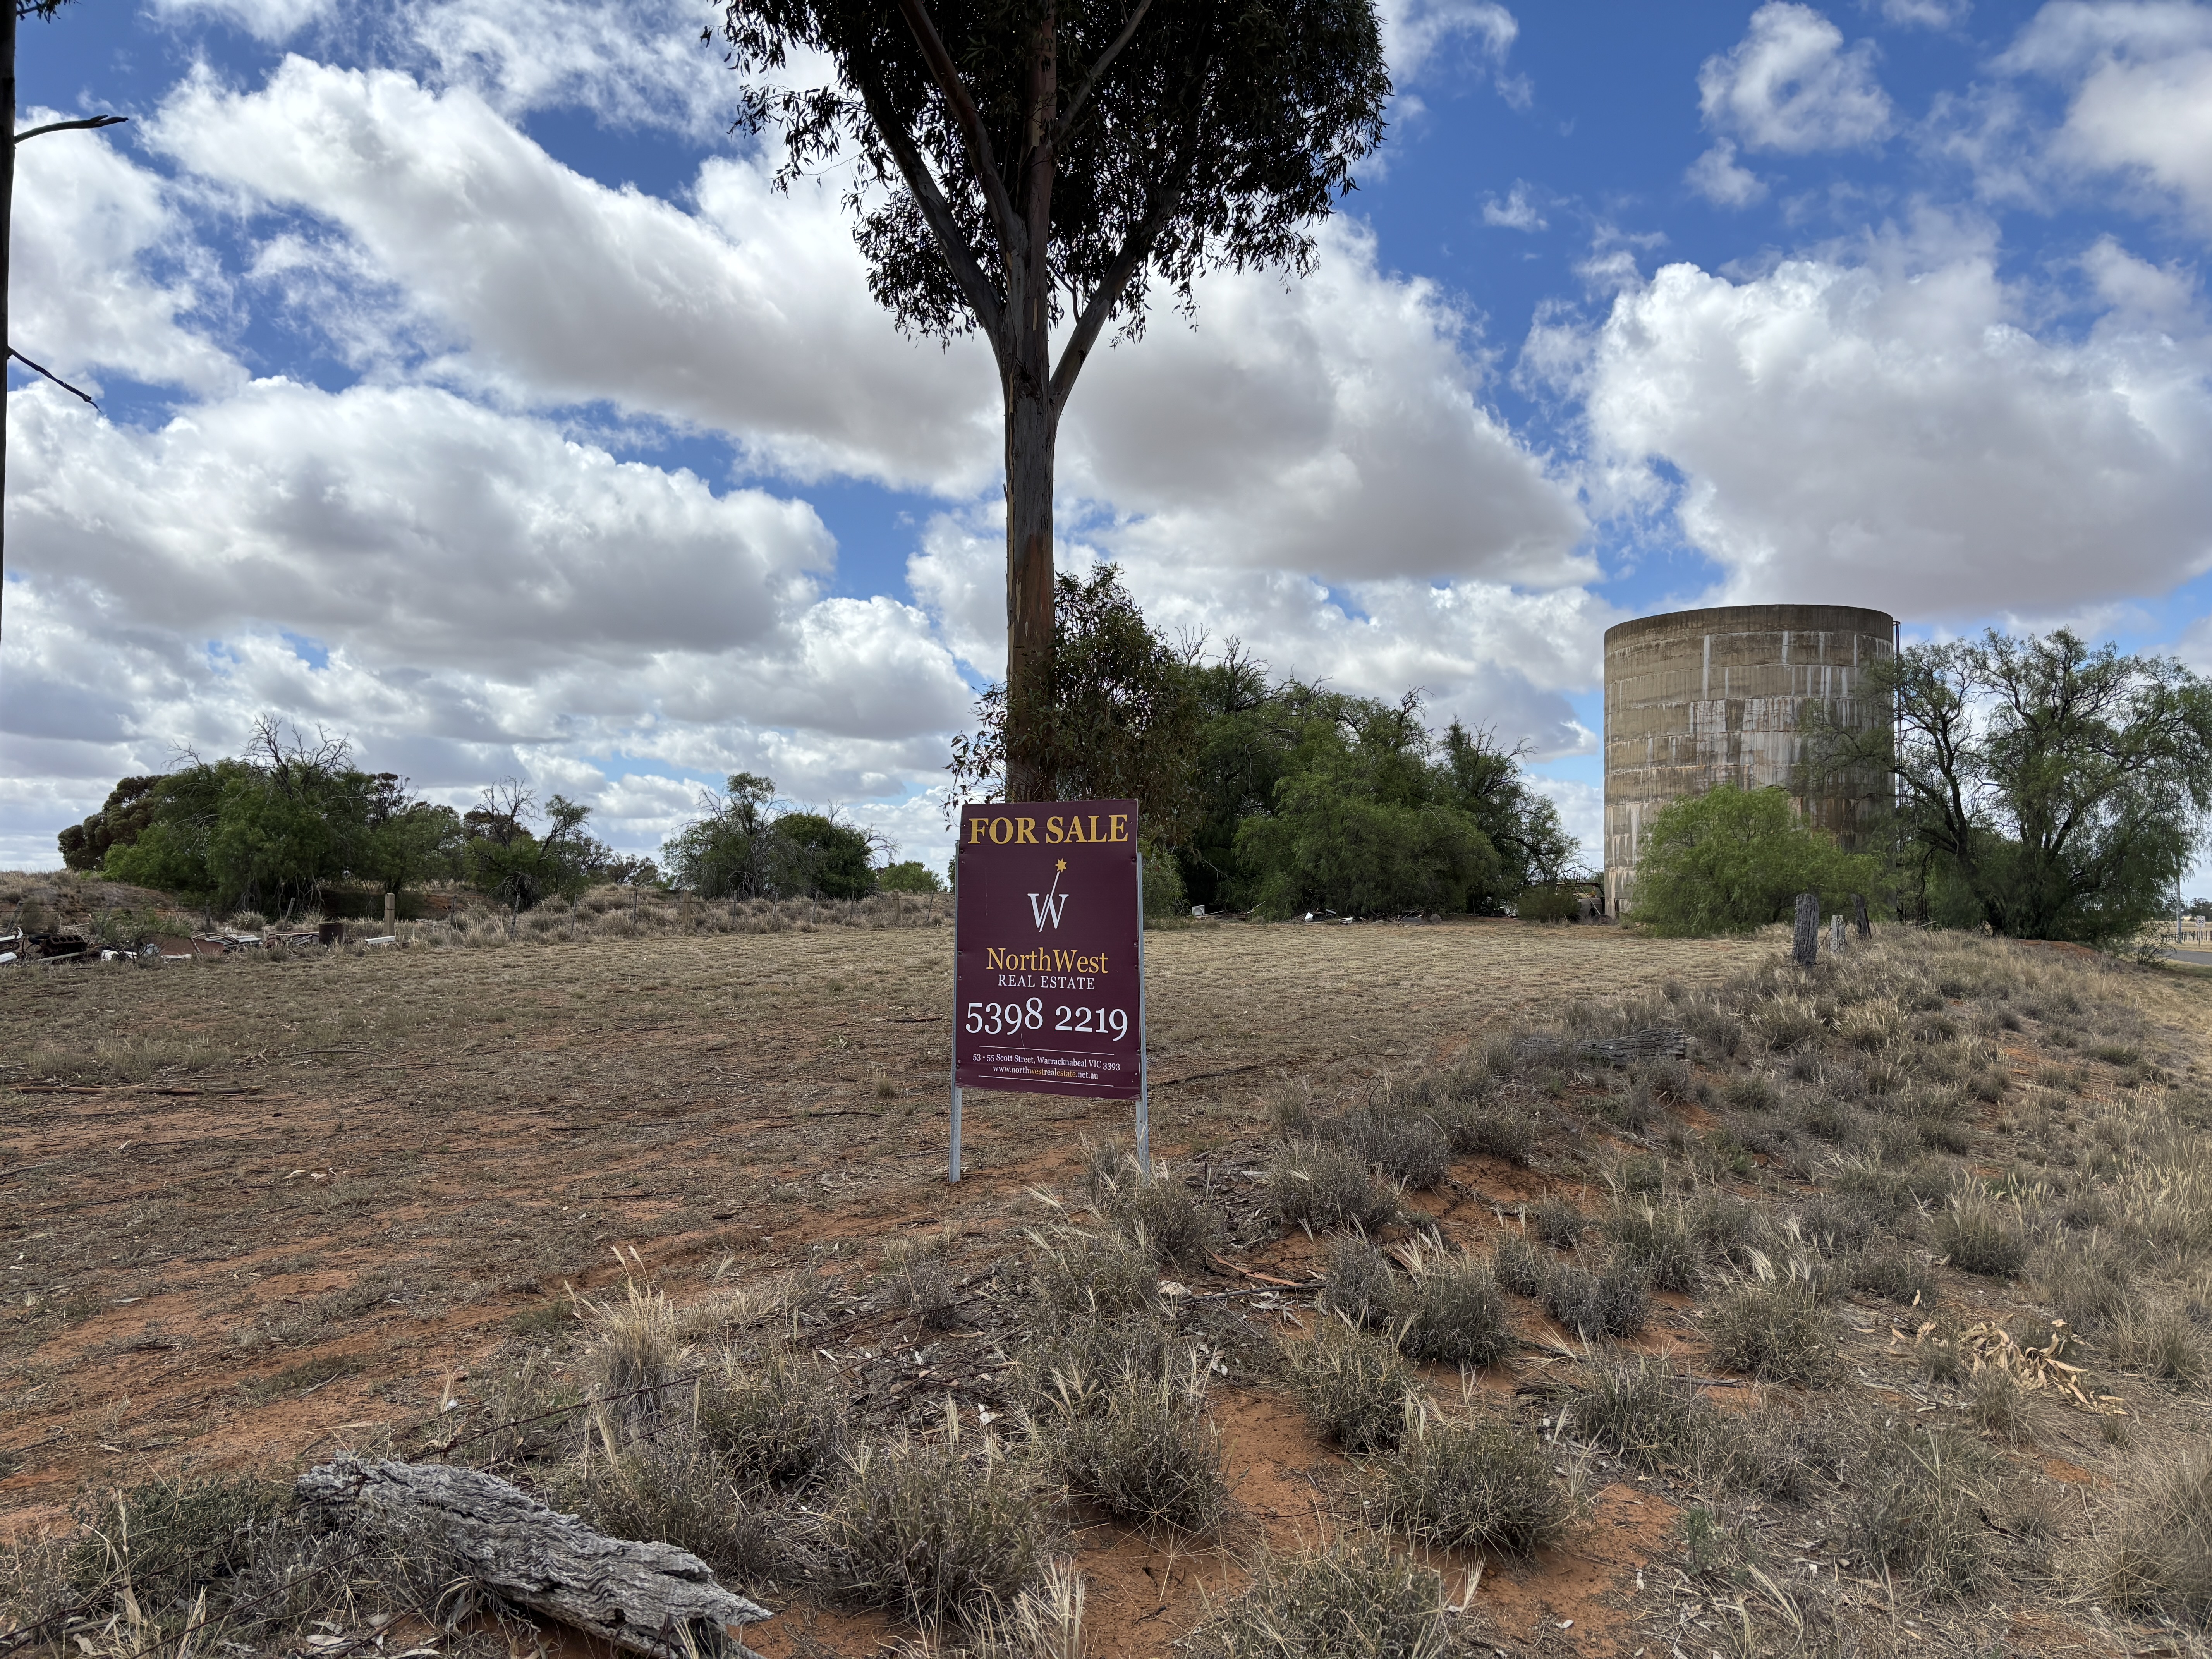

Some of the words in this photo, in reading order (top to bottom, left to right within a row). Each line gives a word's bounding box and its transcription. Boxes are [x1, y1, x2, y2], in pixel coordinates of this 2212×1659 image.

[968, 817, 1039, 844] FOR
[1046, 814, 1128, 843] SALE
[986, 947, 1108, 974] NorthWest
[998, 974, 1035, 987] REAL
[1041, 976, 1095, 990] ESTATE
[965, 997, 1043, 1035] 5398
[1055, 1006, 1128, 1042] 2219
[993, 1066, 1098, 1079] www.northwestrealestate.net.au
[996, 1053, 1013, 1062] Scott
[1014, 1055, 1036, 1065] Street,
[1037, 1056, 1087, 1067] Warracknabeal
[1088, 1060, 1102, 1068] VIC
[1103, 1062, 1120, 1071] 3393
